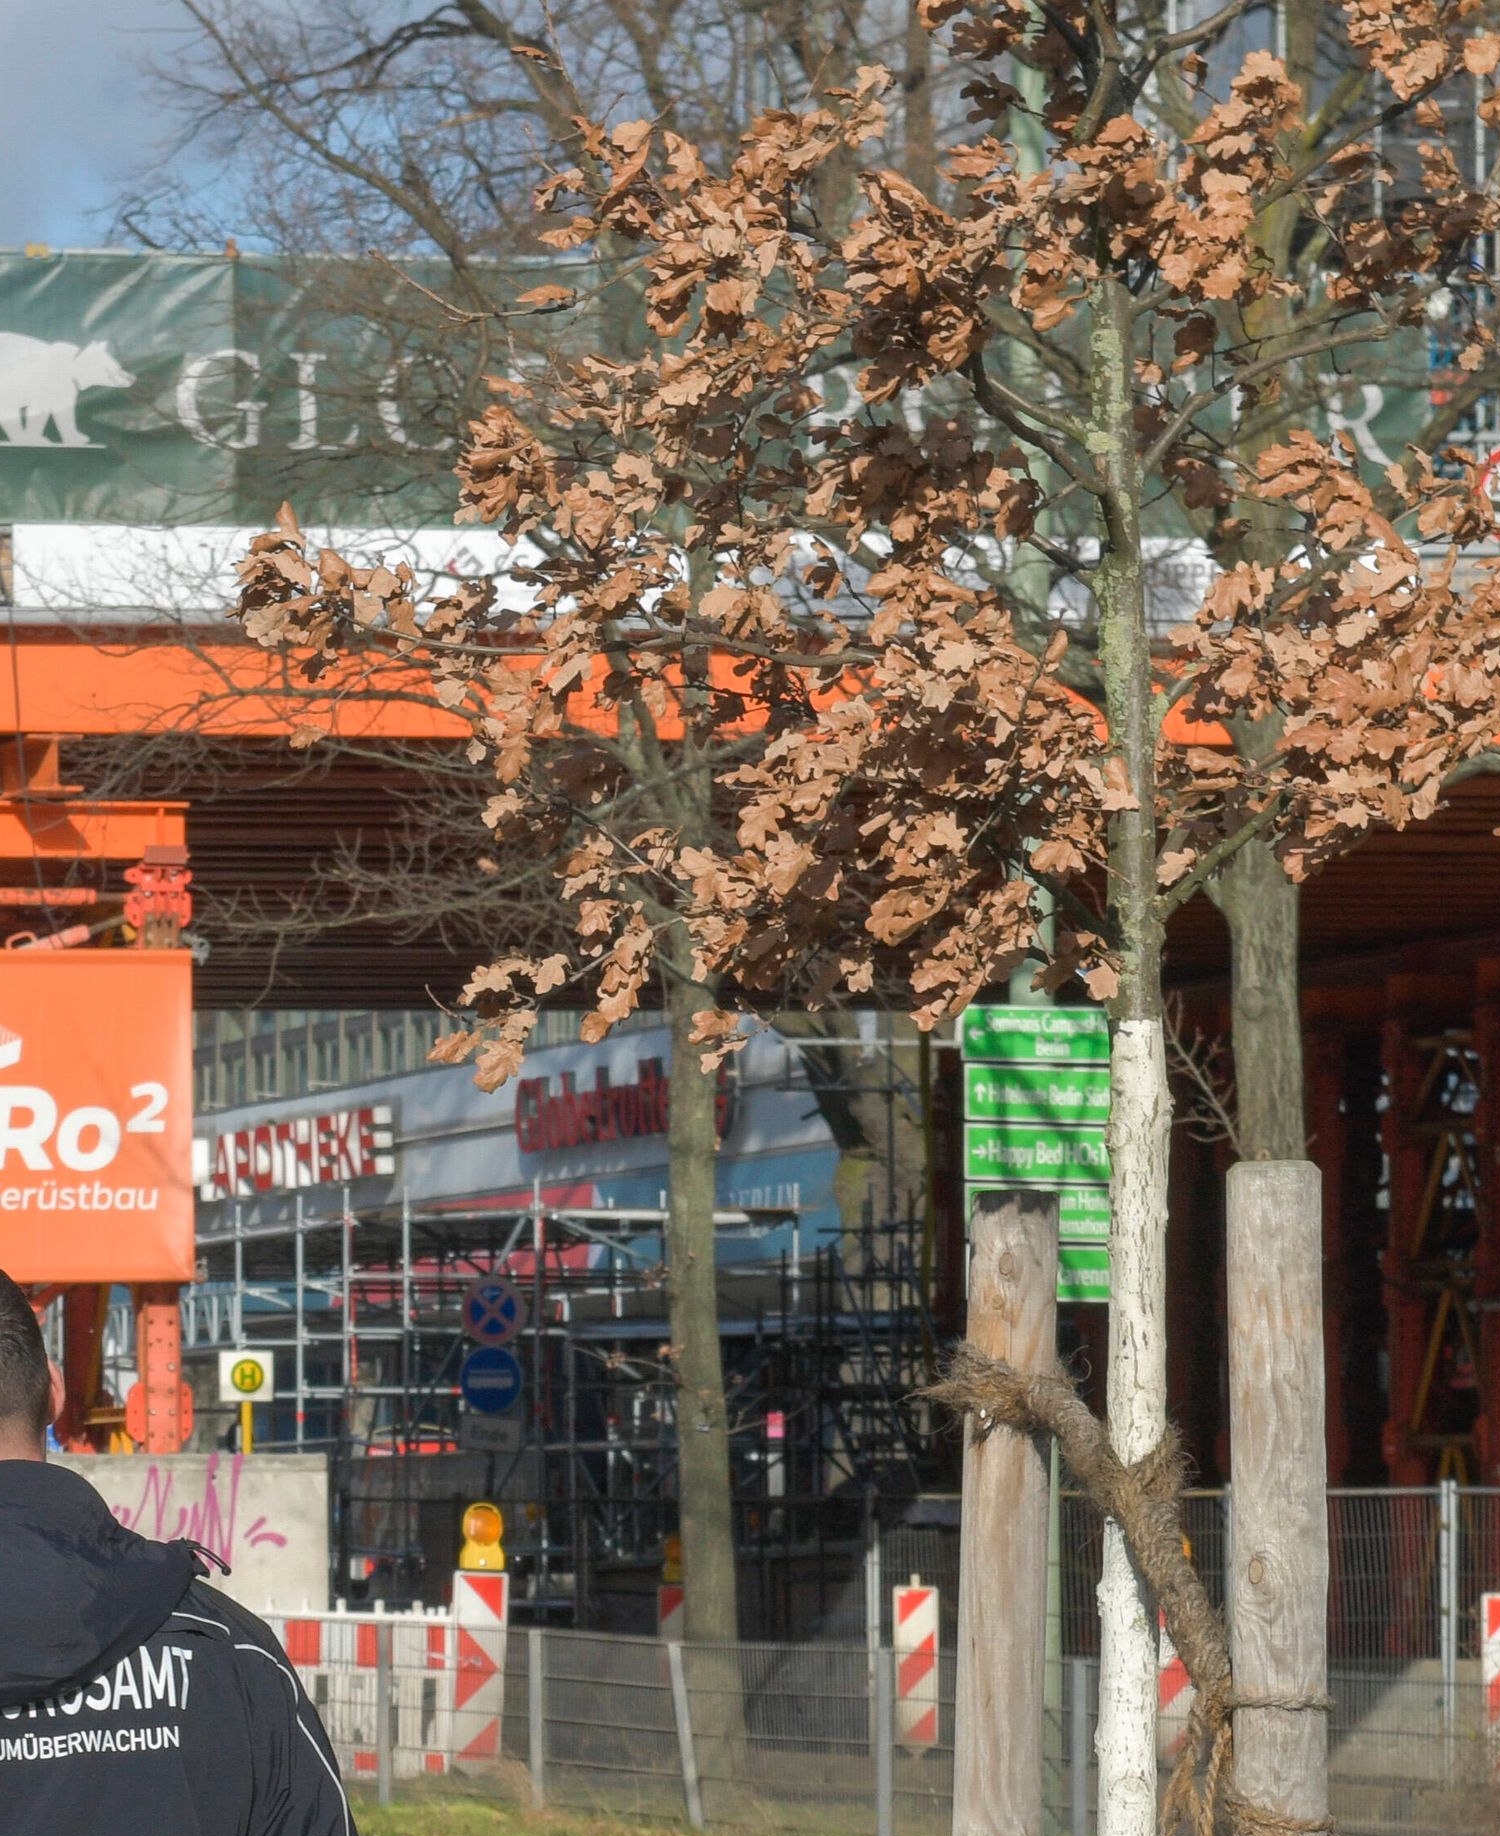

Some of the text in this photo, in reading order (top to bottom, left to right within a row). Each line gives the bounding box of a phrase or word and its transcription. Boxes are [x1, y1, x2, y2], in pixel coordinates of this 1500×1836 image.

[1035, 1036, 1070, 1056] Berlin
[203, 1106, 395, 1200] APOTHEKE
[988, 1139, 1033, 1170] Happy
[1036, 1141, 1063, 1164] Bed
[240, 1369, 256, 1387] H
